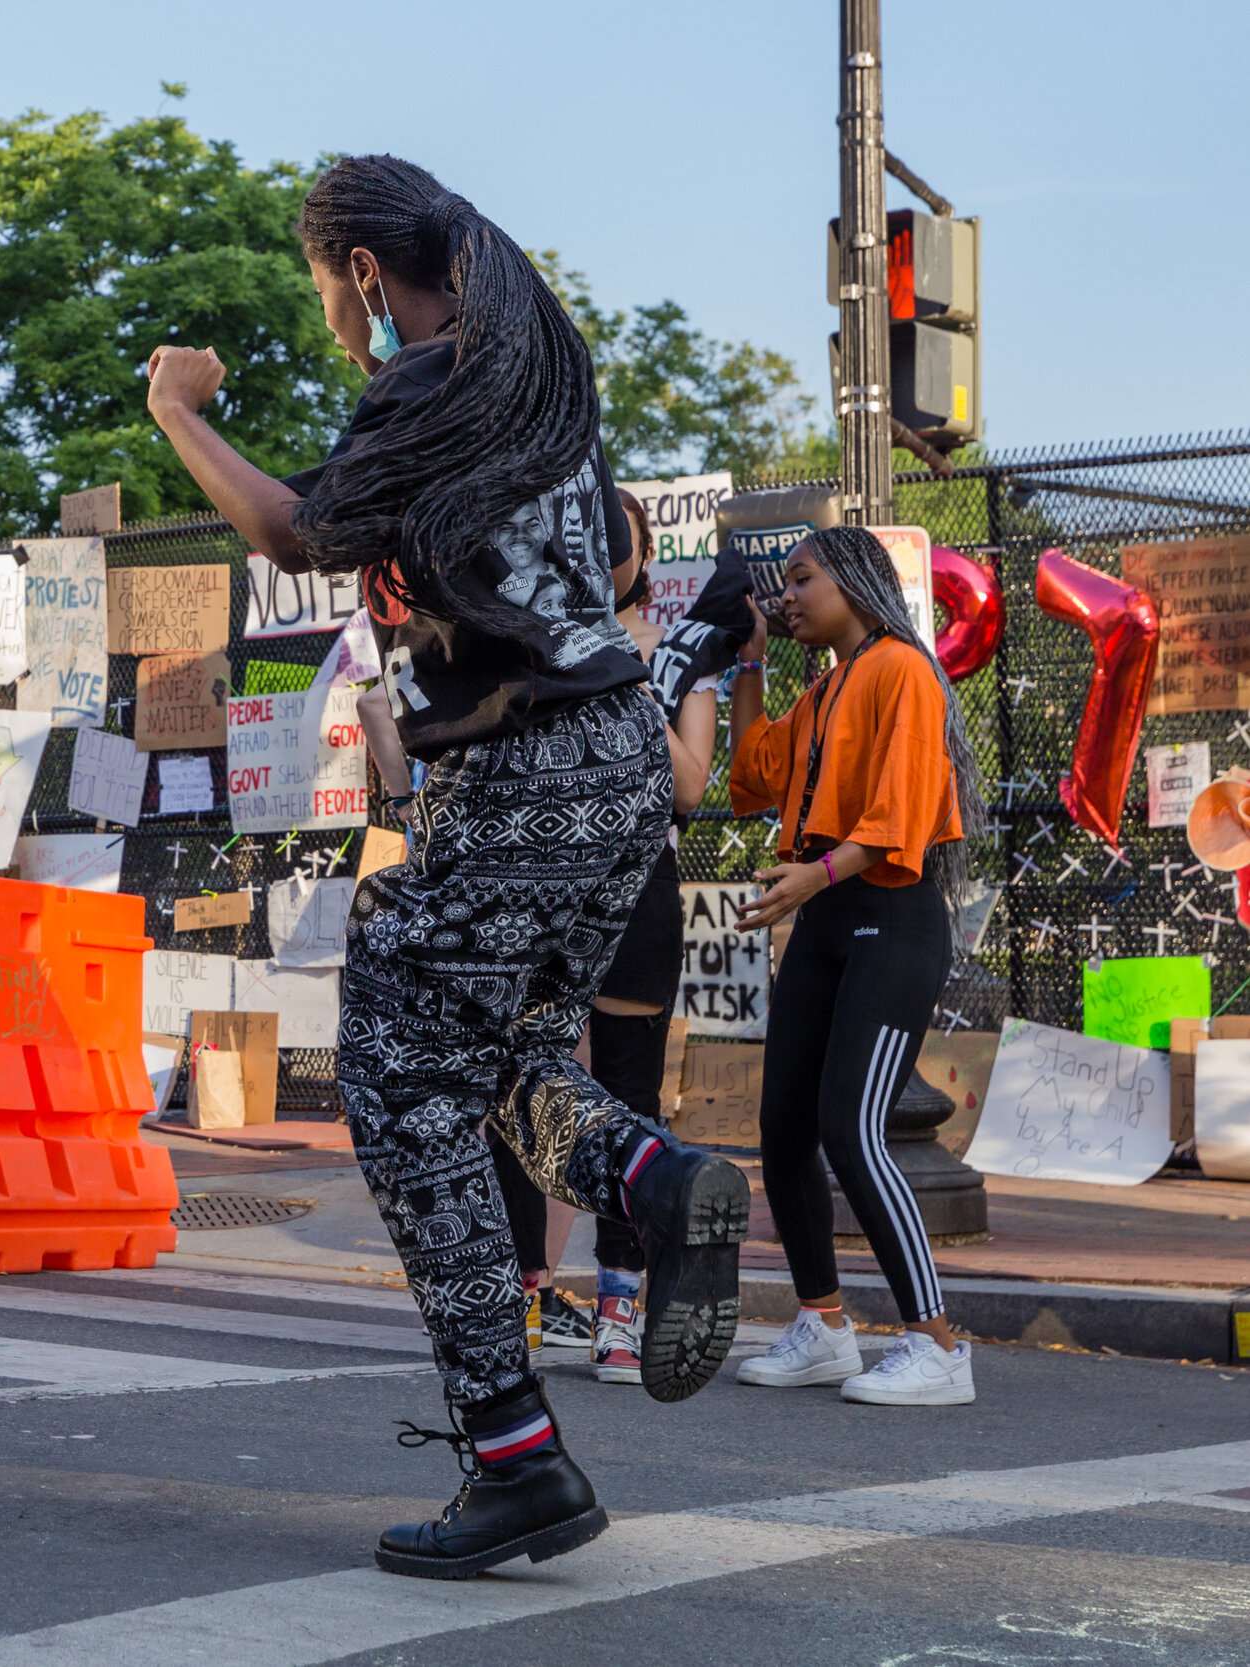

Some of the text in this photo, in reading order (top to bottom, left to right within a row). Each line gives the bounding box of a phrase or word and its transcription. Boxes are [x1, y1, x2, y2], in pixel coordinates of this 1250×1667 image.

[26, 576, 104, 610] PROTEST
[110, 570, 222, 591] TEAR DOWN ALL
[516, 577, 530, 590] BELL
[118, 591, 211, 611] CONFEDERATE
[248, 562, 357, 629] VOTE
[124, 611, 199, 628] SYMBOLS OF
[118, 629, 203, 652] OPPRESSION
[148, 658, 201, 679] BLACK
[58, 668, 103, 706] VOTE
[148, 679, 204, 703] LIVES
[228, 699, 274, 726] PEOPLE
[77, 730, 147, 771] DEFUND
[229, 730, 269, 756] AFRAID
[229, 766, 271, 794] GOVT
[278, 755, 333, 785] SHOULD
[341, 757, 359, 778] BE
[70, 770, 140, 823] POLICE
[231, 795, 266, 821] AFRAID
[271, 793, 312, 817] THEIR
[314, 788, 367, 817] PEOPLE
[854, 927, 879, 937] adidas
[156, 952, 208, 980] SILENCE
[170, 980, 184, 1003] IS
[684, 983, 759, 1022] RISK
[1114, 984, 1183, 1023] Justice
[207, 1017, 269, 1041] BLACK
[1028, 1029, 1108, 1085] Stand
[1021, 1075, 1143, 1129] My Child
[1048, 1122, 1091, 1153] Are
[1097, 1135, 1123, 1161] A
